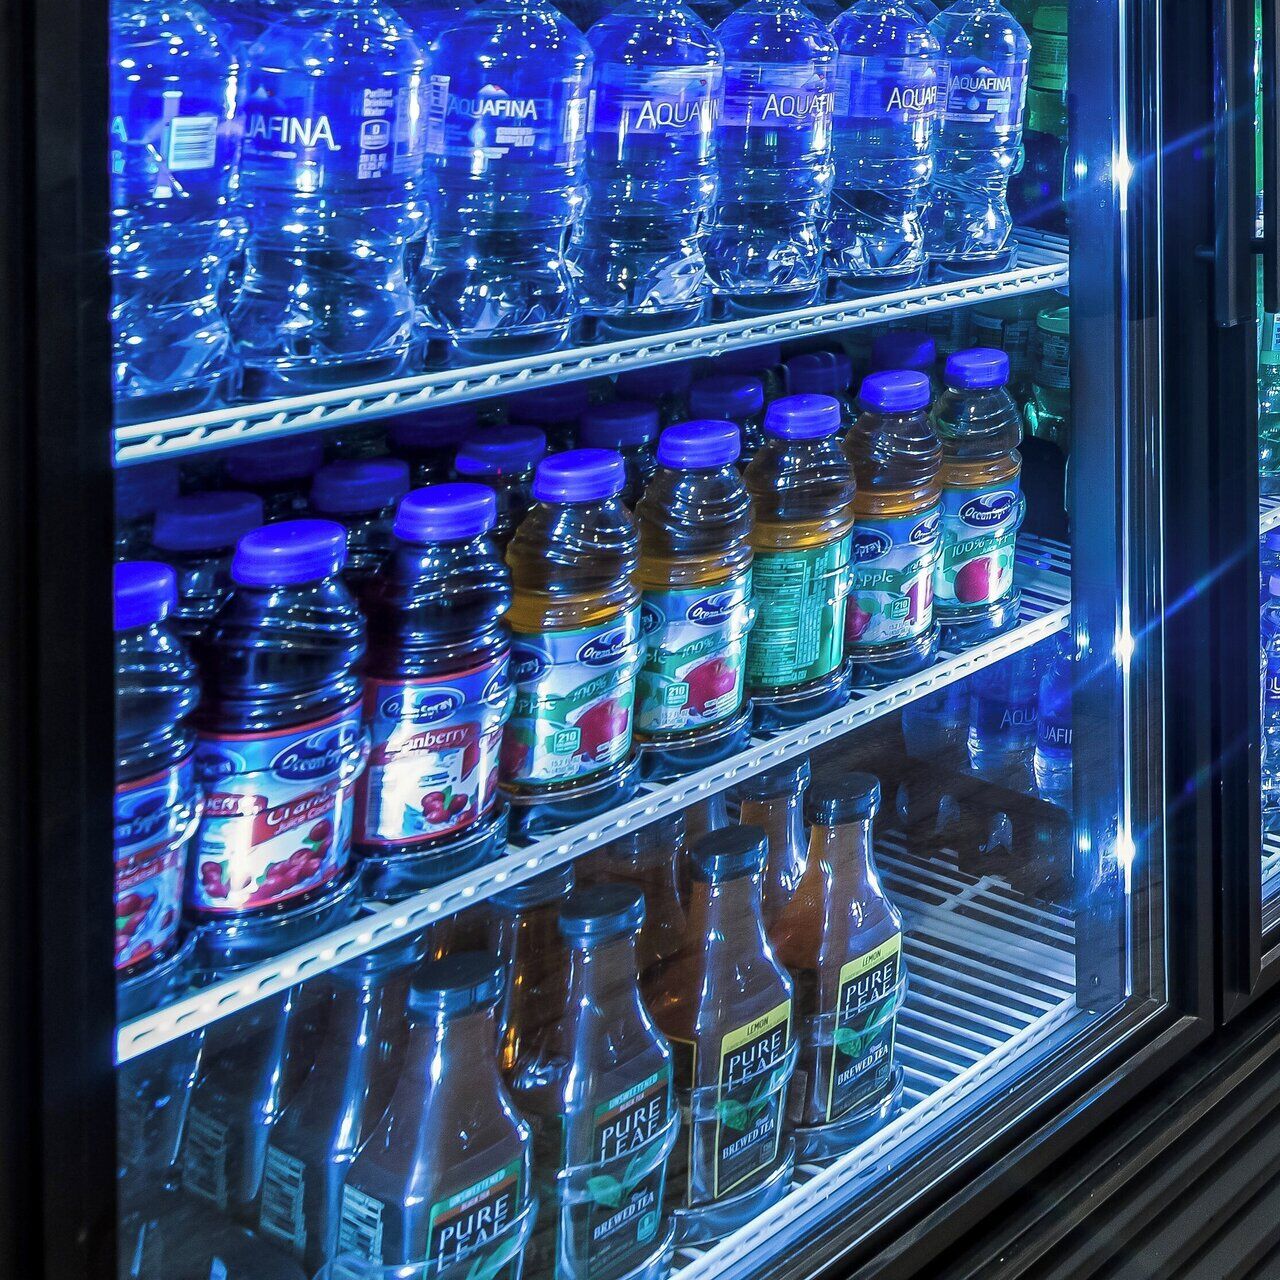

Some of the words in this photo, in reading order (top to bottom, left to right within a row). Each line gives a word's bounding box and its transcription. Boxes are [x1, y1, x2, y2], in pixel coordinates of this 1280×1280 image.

[949, 75, 1012, 93] AQUAFINA
[446, 98, 538, 121] AQUAFINA
[951, 538, 985, 558] 100%
[681, 635, 715, 659] 100%
[668, 686, 685, 697] 210
[862, 949, 882, 968] LEMON
[844, 978, 891, 1021] LEAF
[845, 961, 894, 1005] PURE
[746, 1016, 769, 1036] LEMON
[727, 1046, 780, 1093] LEAF
[729, 1029, 782, 1075] PURE
[837, 1055, 873, 1086] BREWED
[873, 1044, 889, 1063] TEA
[600, 1096, 662, 1149] PURE
[600, 1116, 660, 1168] LEAF
[722, 1128, 759, 1160] BREWED
[760, 1118, 774, 1136] TEA
[438, 1193, 510, 1251] PURE
[593, 1204, 637, 1241] BREWED
[637, 1191, 655, 1211] TEA
